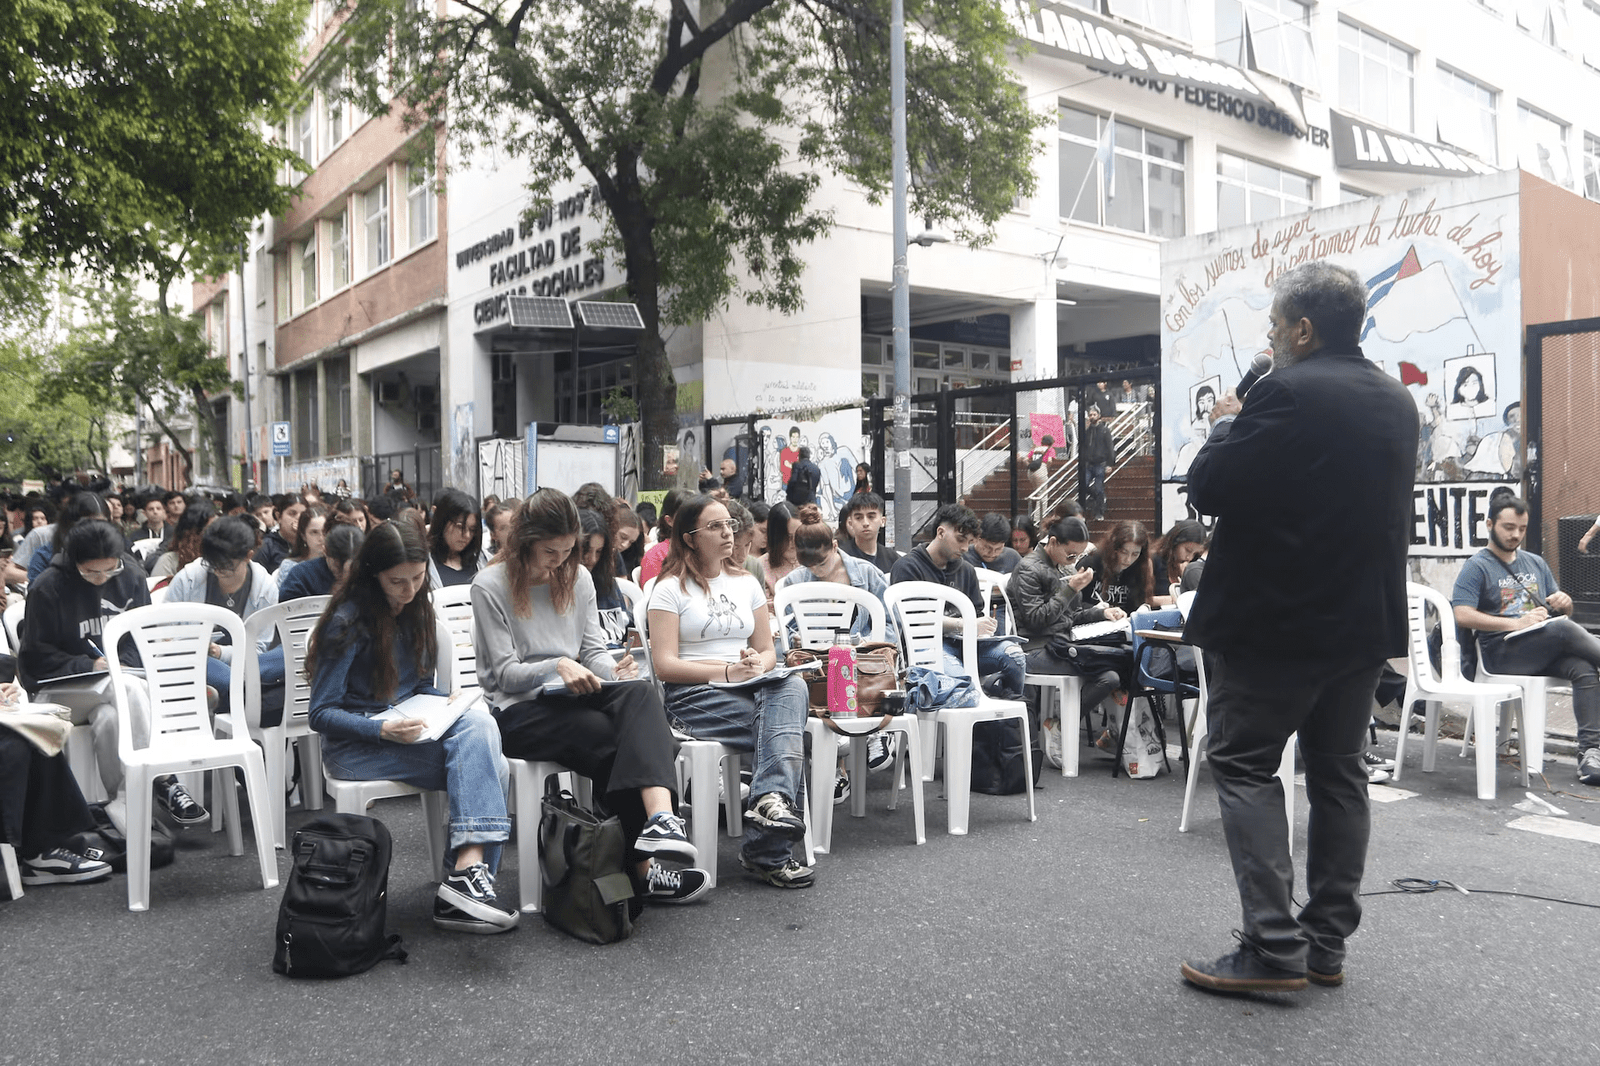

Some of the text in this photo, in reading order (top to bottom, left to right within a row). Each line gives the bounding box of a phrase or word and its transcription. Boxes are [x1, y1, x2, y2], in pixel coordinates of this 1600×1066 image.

[1001, 0, 1148, 70] LARIOS
[1174, 82, 1256, 123] FEDERICO
[1352, 125, 1388, 162] LA
[456, 227, 514, 269] UNIVERSIDAD
[489, 225, 581, 288] FACULTAD DE
[1264, 197, 1504, 291] despertamos la lucha de hoy
[531, 256, 605, 298] SOCIALES
[1164, 214, 1316, 333] Con los sueños de ayer
[79, 614, 116, 639] PU
